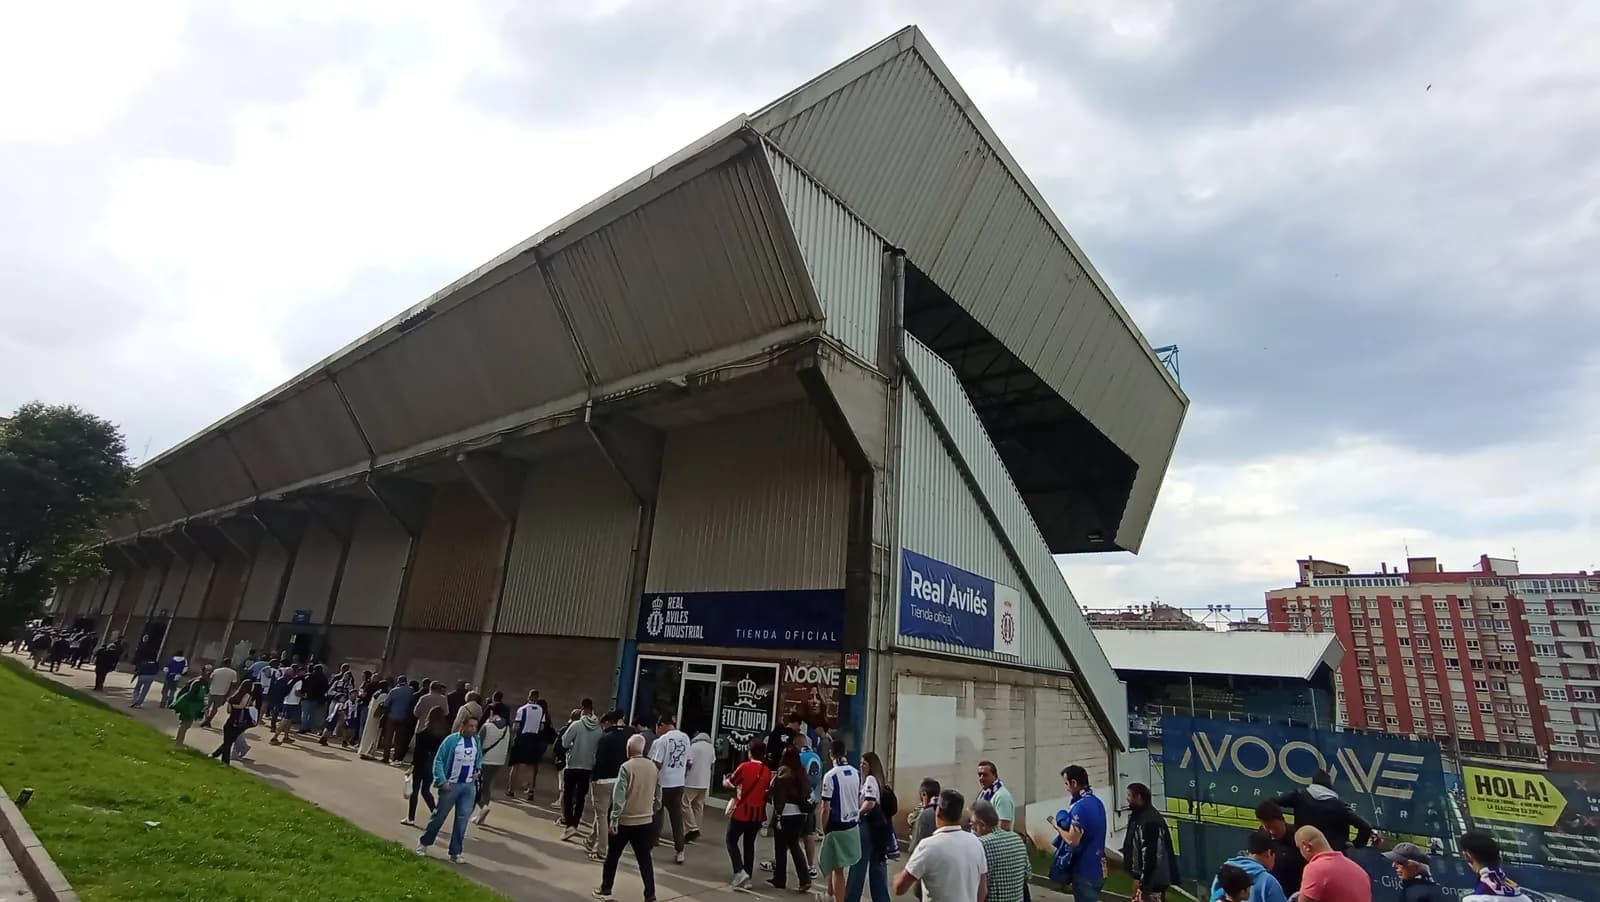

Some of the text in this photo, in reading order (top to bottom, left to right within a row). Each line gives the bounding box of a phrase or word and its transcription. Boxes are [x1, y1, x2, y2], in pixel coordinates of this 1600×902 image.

[667, 596, 684, 609] REAL
[911, 570, 988, 617] Real Avilés
[910, 603, 933, 621] Tienda
[663, 625, 704, 639] INDUSTRIAL
[735, 628, 838, 641] TIENDA OFICIAL
[784, 664, 841, 686] NOONE
[726, 708, 737, 727] TU
[738, 709, 768, 731] EQUIPO
[1474, 774, 1549, 803] HOLA!
